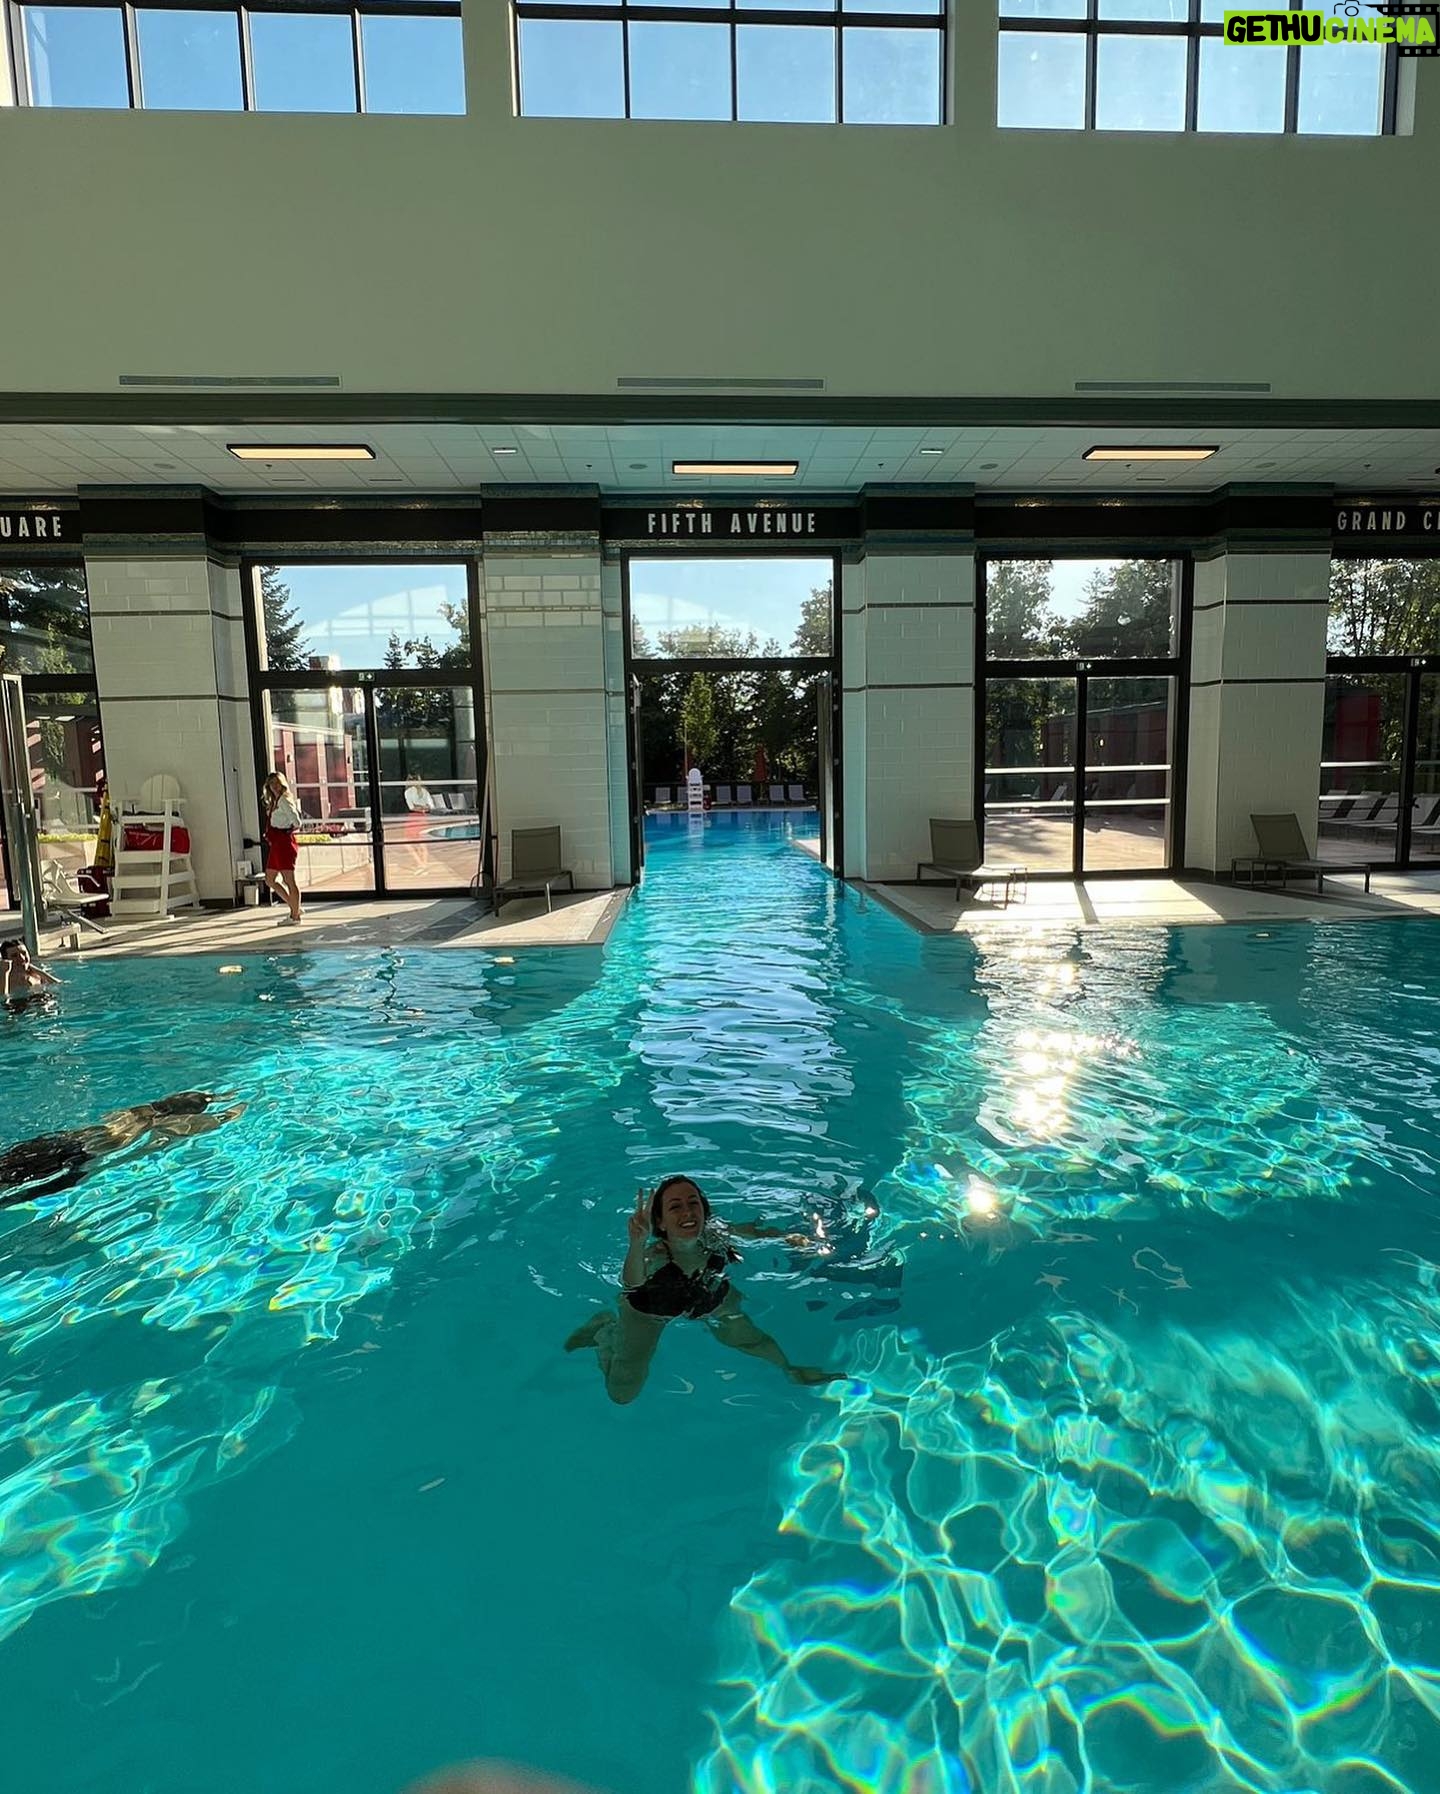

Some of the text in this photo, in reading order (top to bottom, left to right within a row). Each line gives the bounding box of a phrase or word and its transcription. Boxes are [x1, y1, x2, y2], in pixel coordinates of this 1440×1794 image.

[0, 516, 62, 537] UARE
[647, 513, 816, 533] FIFTH AVENUE
[1337, 511, 1406, 530] GRAND
